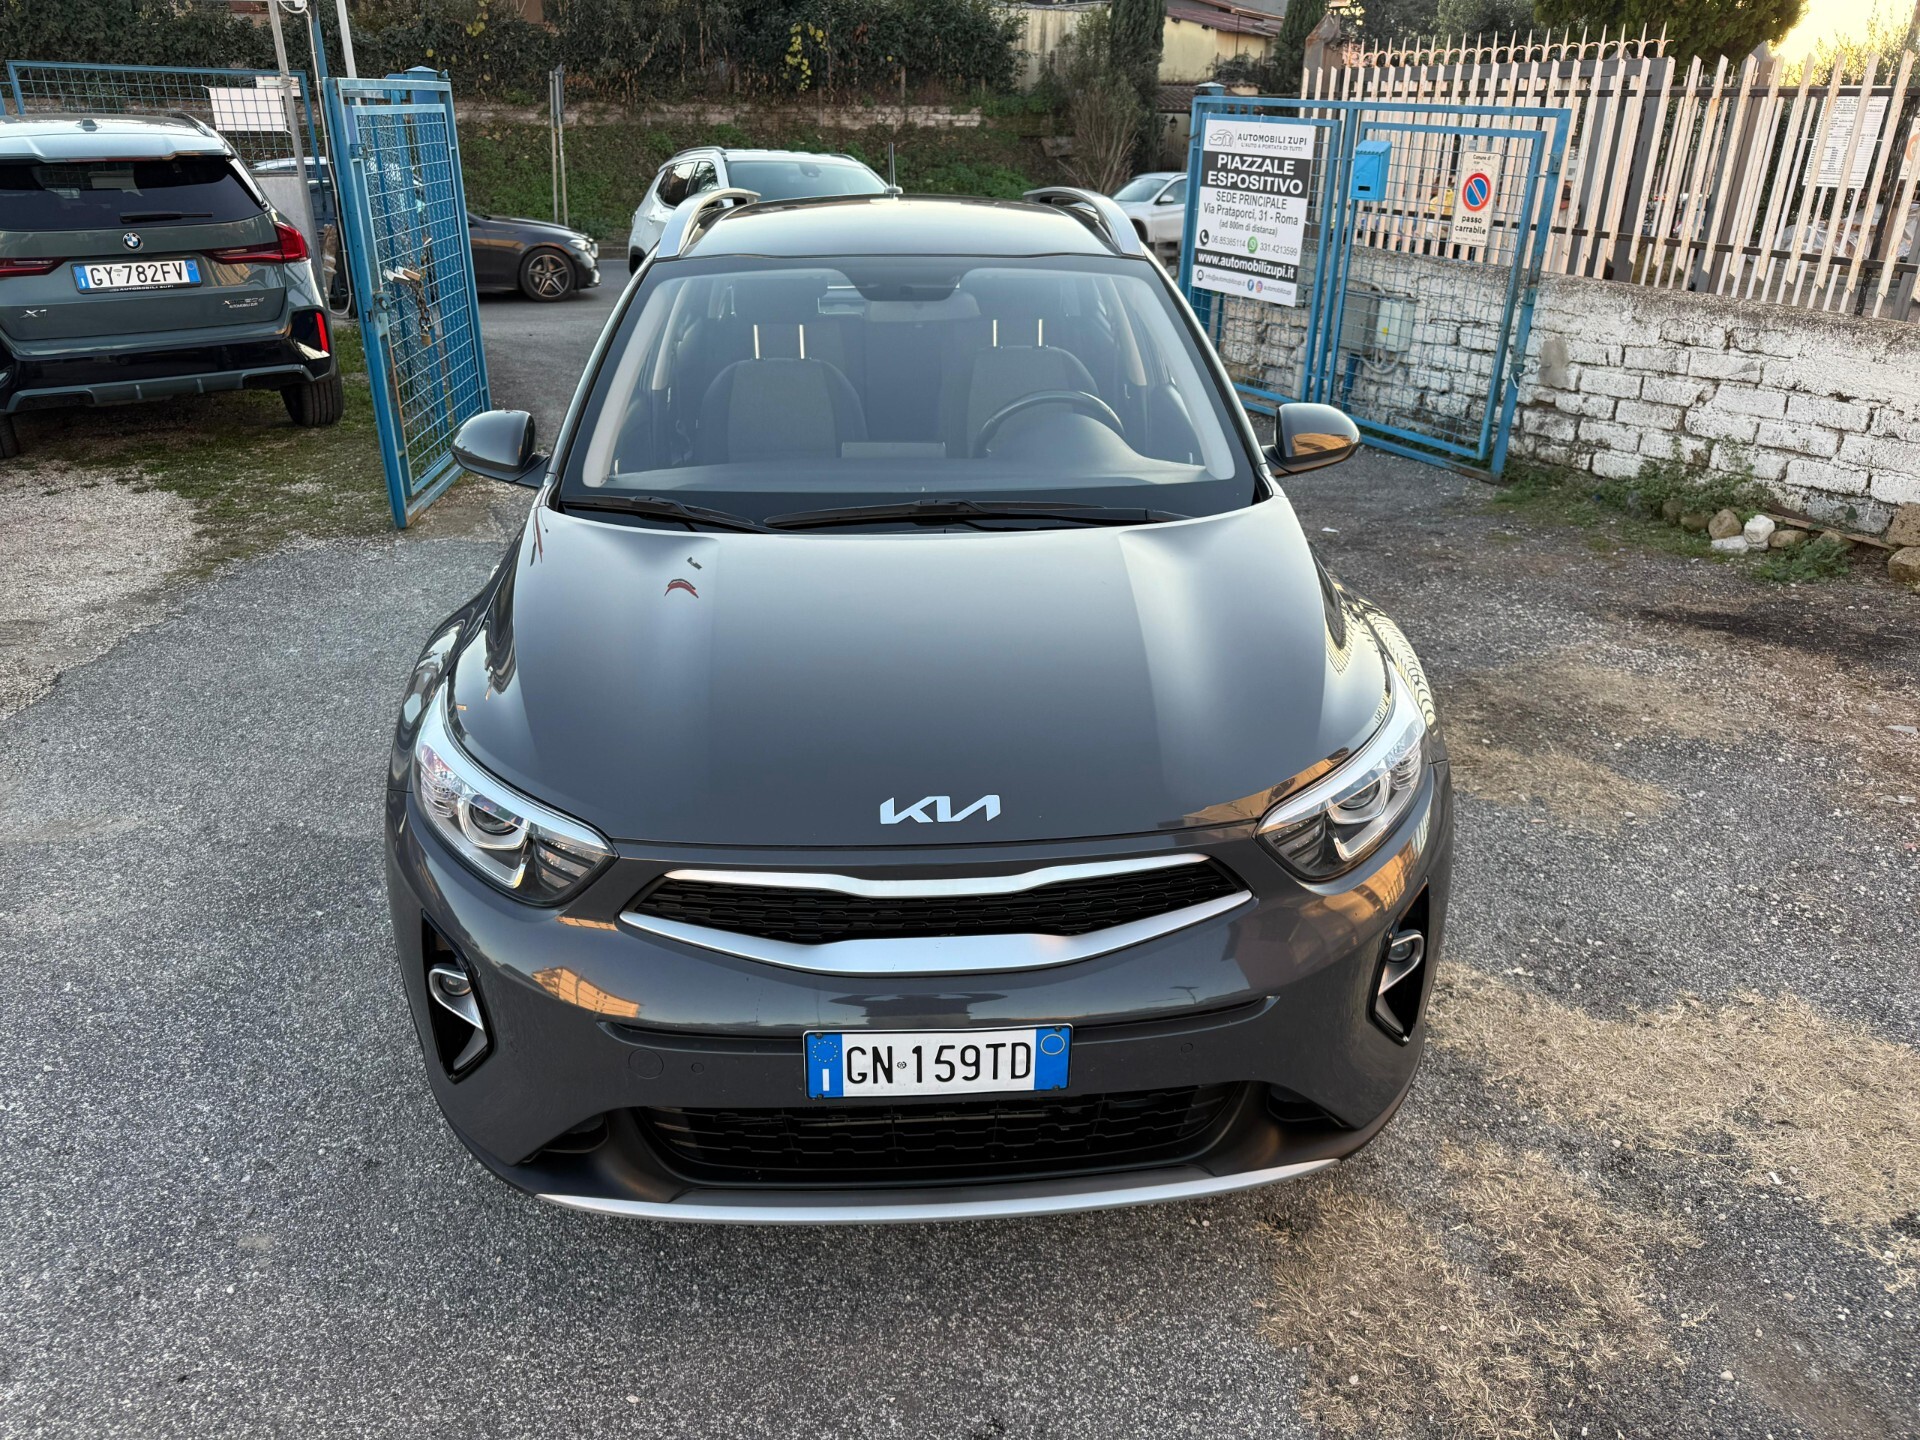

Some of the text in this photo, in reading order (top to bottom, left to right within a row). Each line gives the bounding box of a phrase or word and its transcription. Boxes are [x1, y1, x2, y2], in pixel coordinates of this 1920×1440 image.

[1237, 133, 1307, 146] AUTOMOBILI ZUPI
[1217, 154, 1295, 176] PIAZZALE
[1207, 170, 1303, 195] ESPOSITIVO
[1216, 190, 1287, 210] SEDE PRINCIPALE
[1203, 202, 1215, 214] Via
[1216, 204, 1257, 222] Prataporci,
[1258, 210, 1268, 222] 31
[1274, 211, 1299, 226] Roma
[1461, 215, 1483, 224] passo
[1219, 219, 1278, 237] (ad 800m di distanza)
[1454, 225, 1487, 235] carrabile
[90, 262, 183, 286] GY 782FV
[1197, 252, 1295, 280] www.automobilizupi.it
[19, 308, 48, 319] X1
[880, 794, 1001, 825] KIA
[846, 1042, 1032, 1085] GN 159TD
